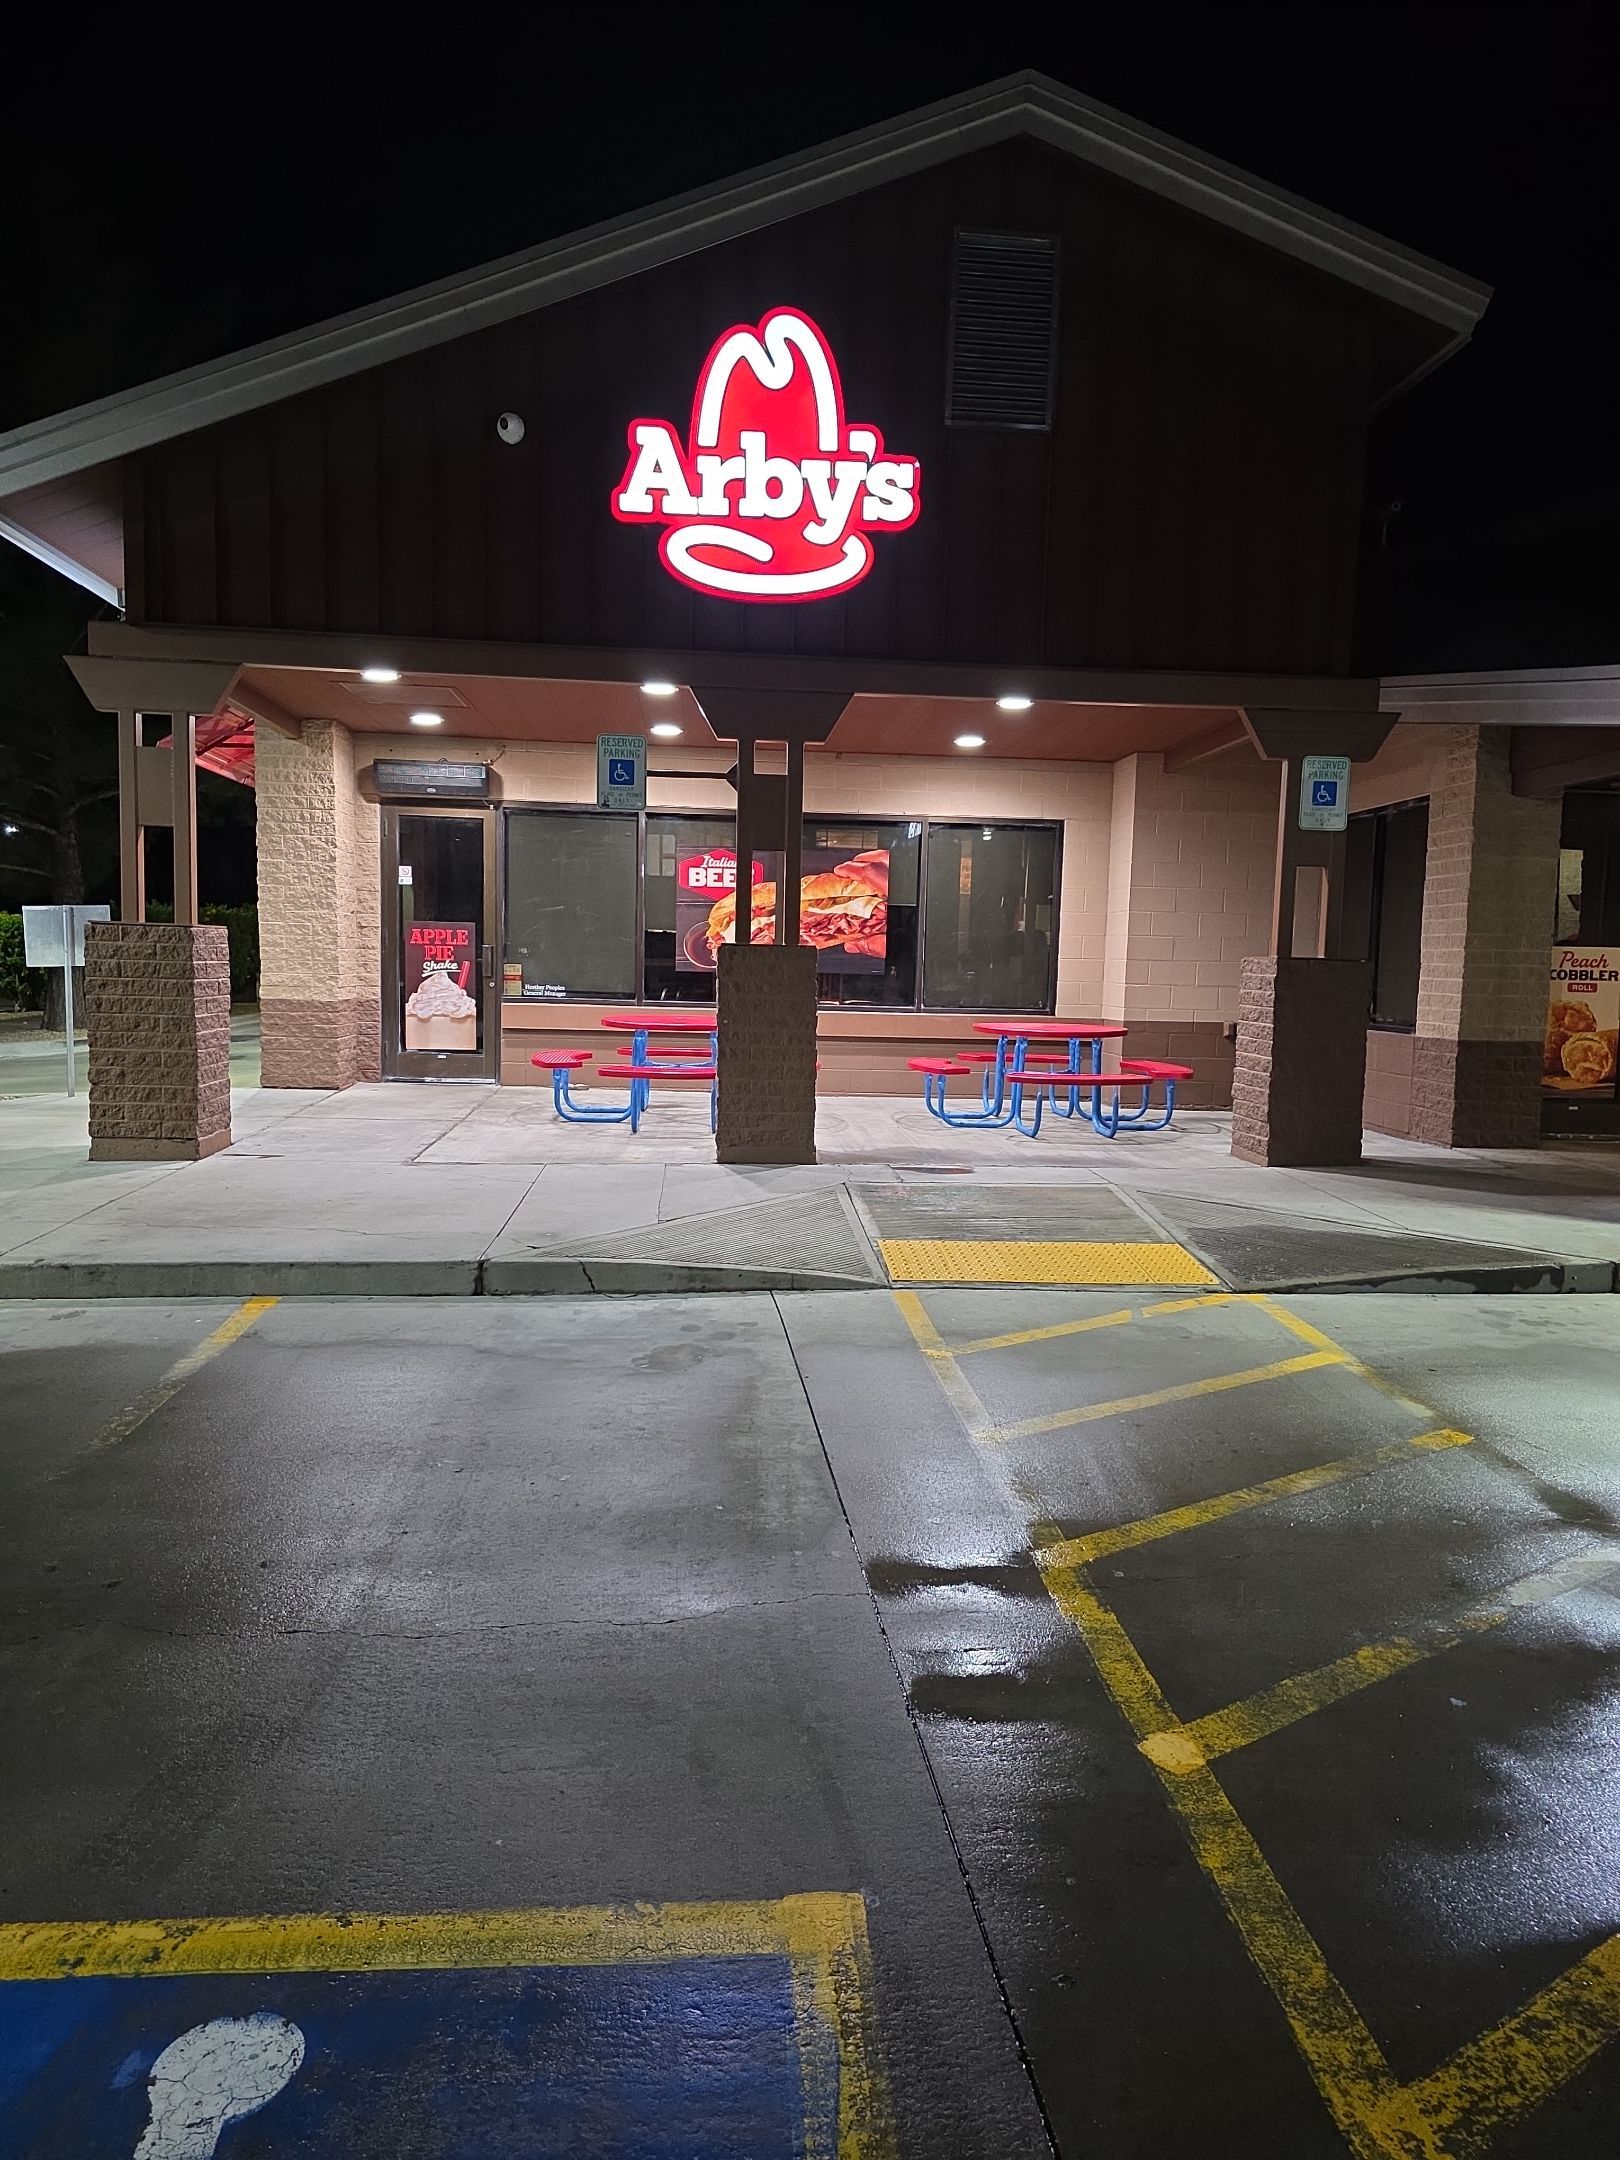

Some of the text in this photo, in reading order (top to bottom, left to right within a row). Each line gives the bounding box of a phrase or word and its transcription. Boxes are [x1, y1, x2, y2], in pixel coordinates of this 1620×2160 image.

[619, 426, 915, 545] Arby's
[601, 737, 644, 748] RESERVED
[603, 748, 641, 758] PARKING
[1306, 760, 1347, 770] RESERVED
[1308, 770, 1344, 780] PARKING
[701, 855, 736, 868] Italia
[688, 867, 755, 888] BEE
[410, 928, 469, 946] APPLE
[424, 945, 454, 960] PIE
[1559, 951, 1610, 968] Peach
[422, 960, 459, 973] Shake
[1550, 969, 1619, 982] COBBLER
